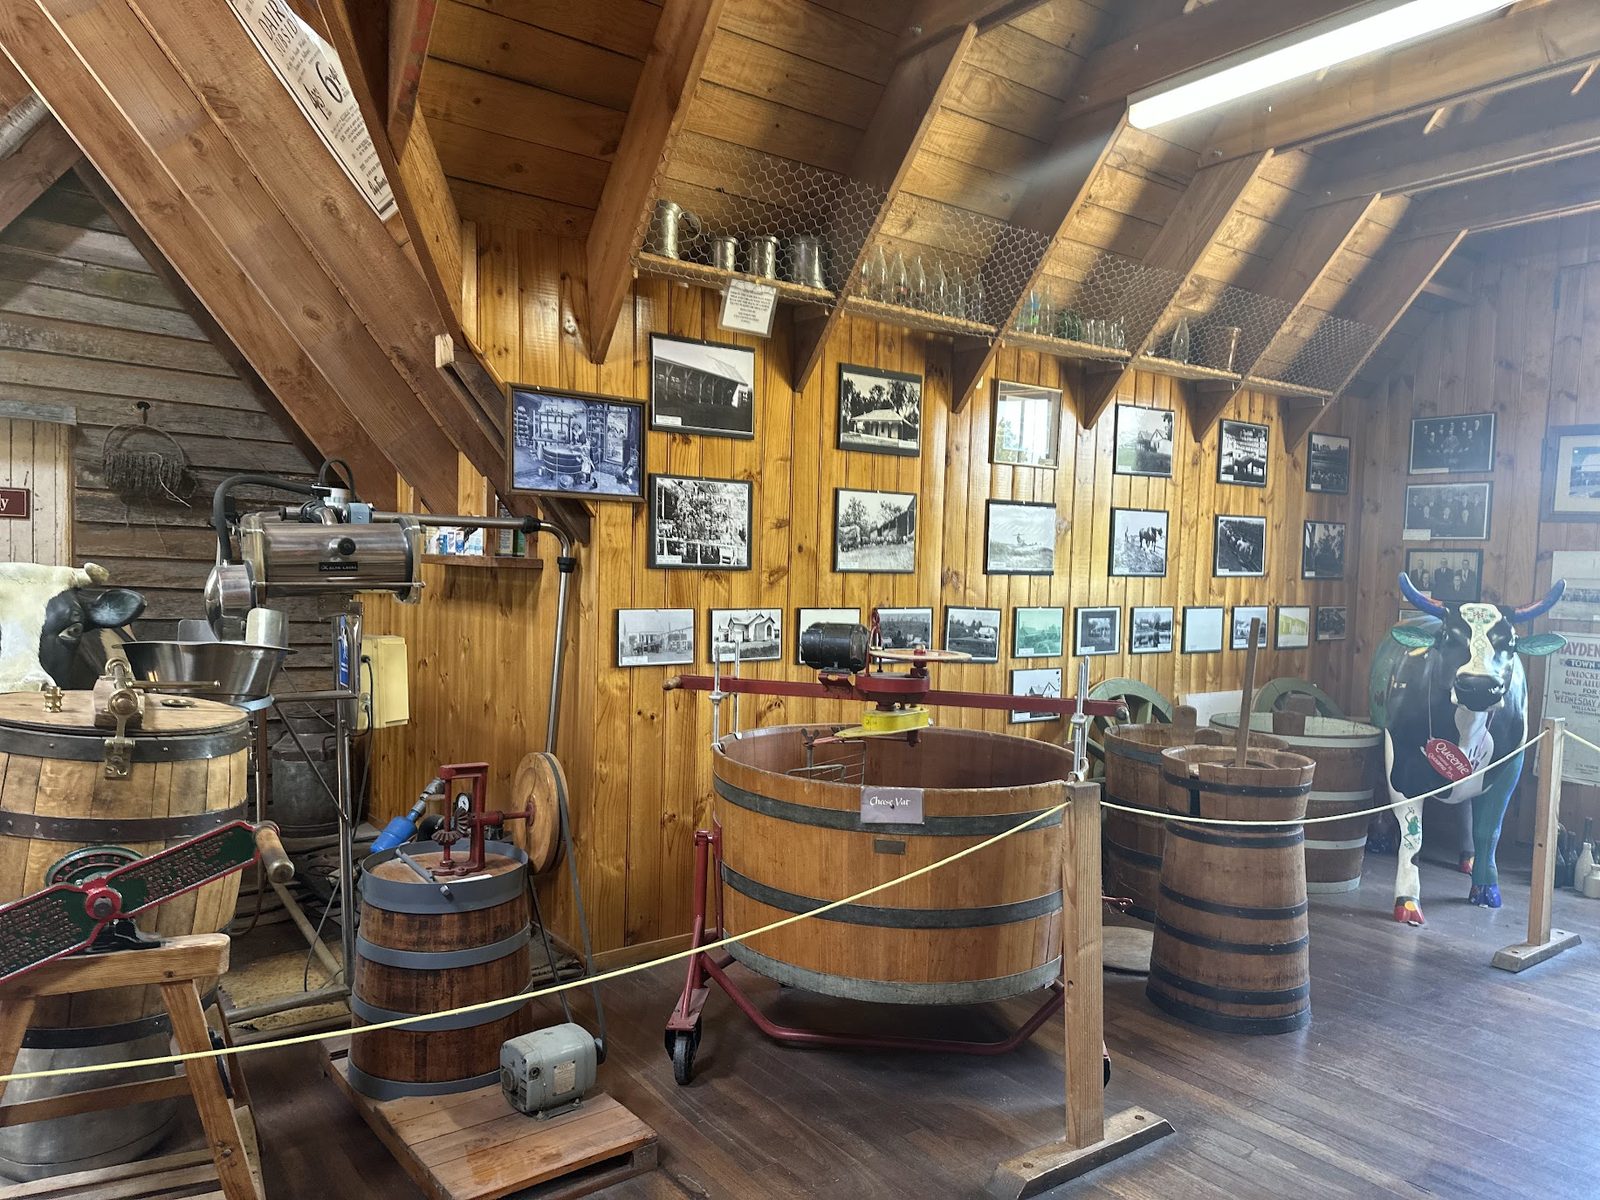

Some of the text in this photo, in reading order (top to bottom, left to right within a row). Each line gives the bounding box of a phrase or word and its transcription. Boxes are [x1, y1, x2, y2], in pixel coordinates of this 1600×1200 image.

[258, 0, 286, 41] DAIR
[273, 18, 298, 57] SUBSID
[1571, 659, 1595, 669] TOWN
[1564, 678, 1582, 686] RICH
[1554, 694, 1597, 708] WEDNESDAY
[1435, 742, 1470, 775] Queenie
[869, 796, 911, 807] Cheese Vat
